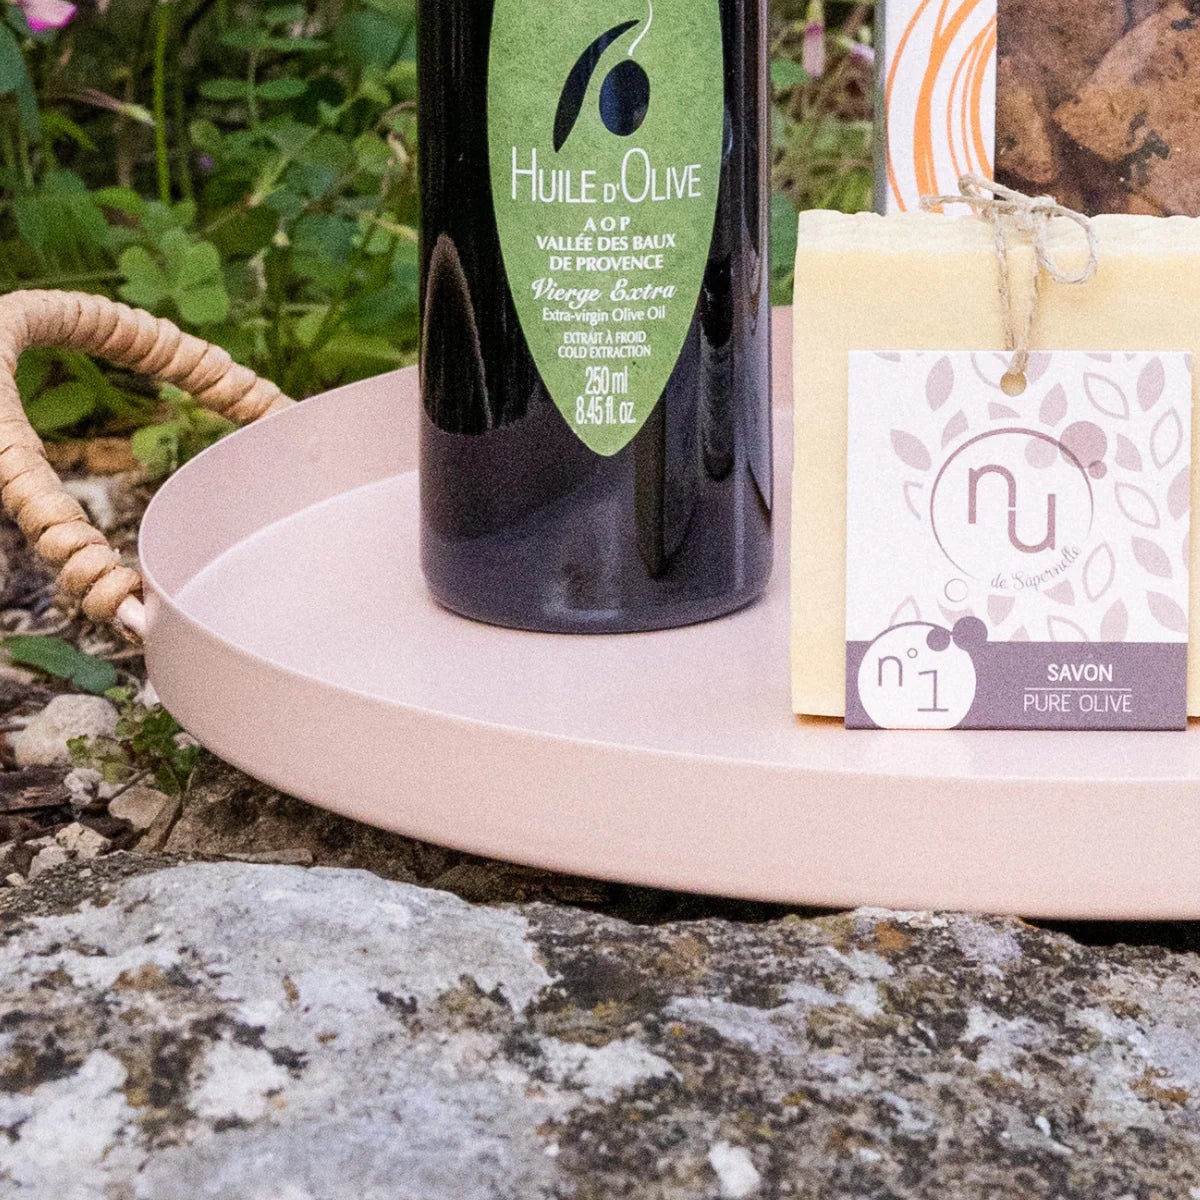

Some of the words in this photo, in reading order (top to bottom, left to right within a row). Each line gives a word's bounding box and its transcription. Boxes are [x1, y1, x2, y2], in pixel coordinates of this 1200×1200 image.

[536, 233, 593, 251] VALLÉE
[597, 236, 629, 251] DES
[632, 233, 676, 250] BAUX
[549, 256, 572, 271] DE
[575, 254, 664, 271] PROVENCE
[531, 277, 602, 310] Vierge
[609, 278, 677, 302] Extra
[542, 307, 609, 326] Extra-virgin
[612, 307, 645, 322] Olive
[647, 305, 666, 320] Oil
[563, 331, 604, 344] EXTRAIT
[615, 330, 647, 344] FROID
[558, 346, 587, 359] COLD
[589, 345, 652, 358] EXTRACTION
[585, 366, 609, 395] 250
[611, 365, 628, 394] ml
[575, 396, 604, 425] 8.45
[1047, 663, 1113, 682] SAVON
[1023, 694, 1071, 712] PURE
[1079, 694, 1132, 712] OLIVE
